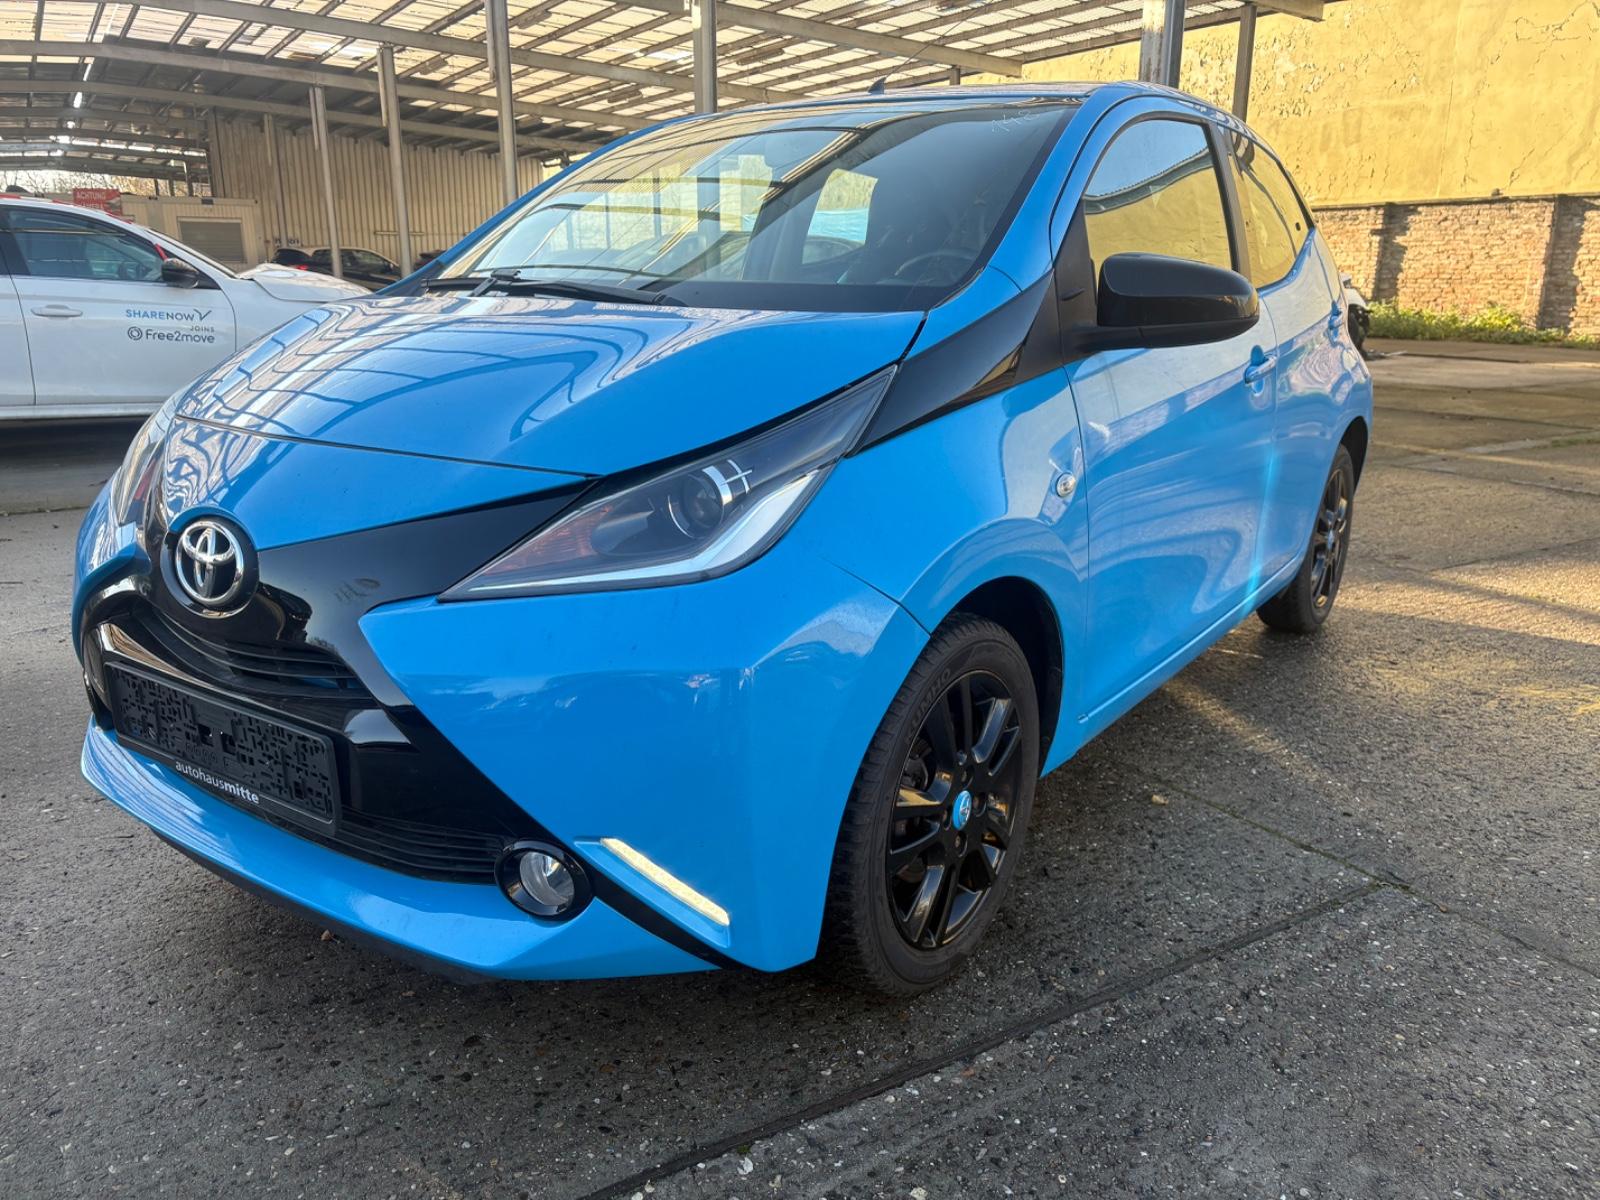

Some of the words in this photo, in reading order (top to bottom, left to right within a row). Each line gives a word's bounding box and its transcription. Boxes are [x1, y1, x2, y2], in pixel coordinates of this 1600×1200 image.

[76, 190, 106, 200] ACHTUNG
[125, 309, 195, 321] SHARENOW
[145, 328, 215, 343] Free2move
[904, 668, 951, 744] KUMHO
[175, 760, 259, 804] autohausmitte
